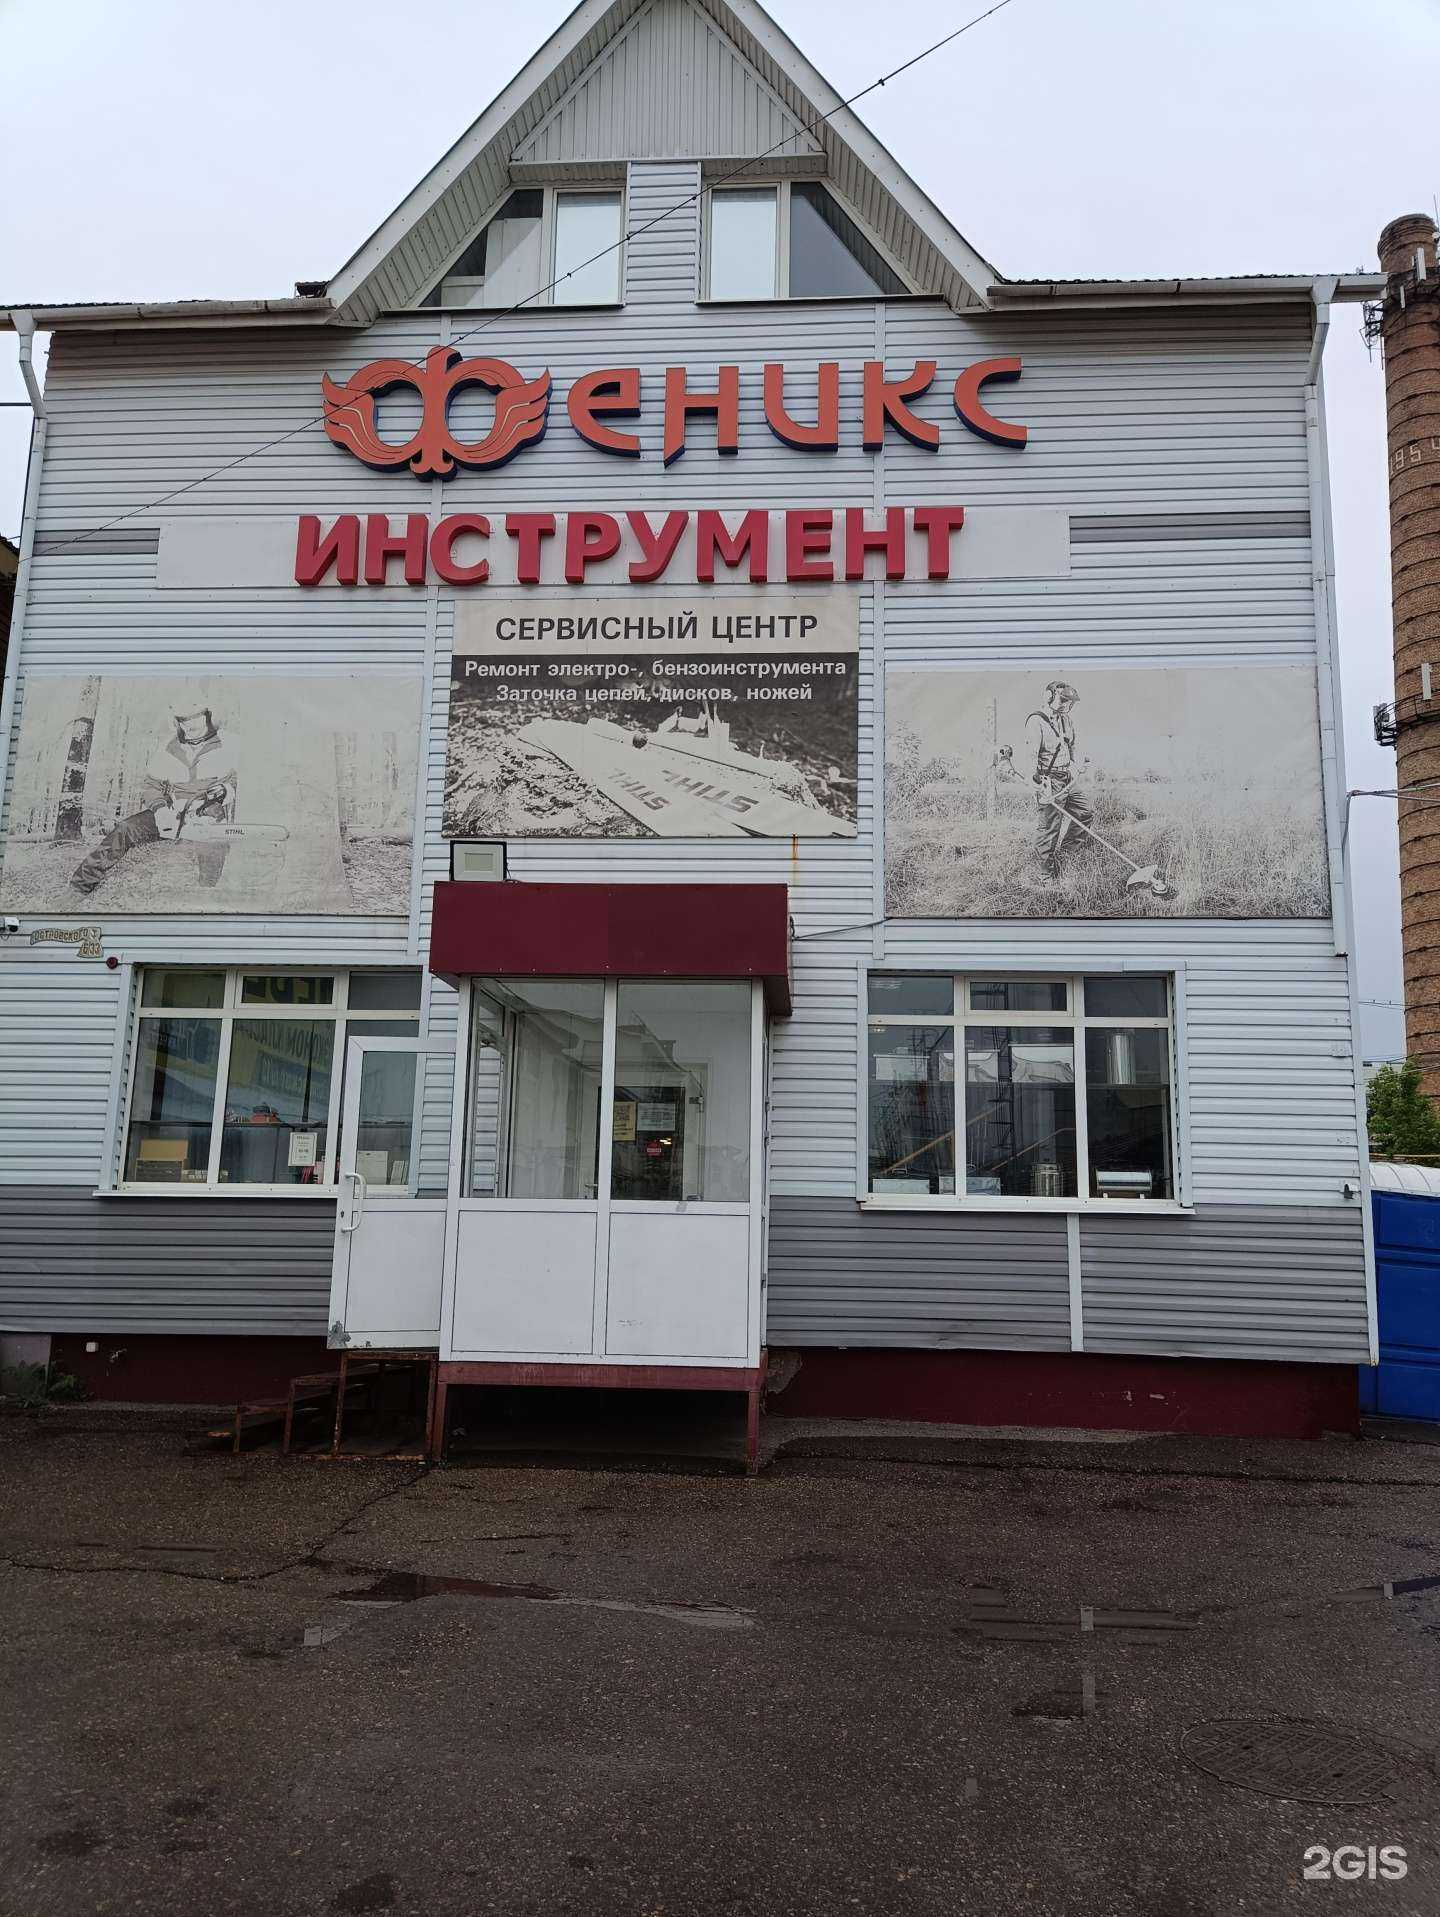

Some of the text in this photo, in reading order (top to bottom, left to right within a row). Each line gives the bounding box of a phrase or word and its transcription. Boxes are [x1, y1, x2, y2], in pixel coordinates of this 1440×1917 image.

[294, 506, 964, 586] ИНСТРУМЕНТ
[496, 611, 819, 643] СЕРВИСНЫЙ ЦЕНТР
[465, 660, 541, 678] Ремонт
[652, 659, 847, 680] бензоинструмента
[496, 684, 812, 703] Заточка цепей, дисков, ножей
